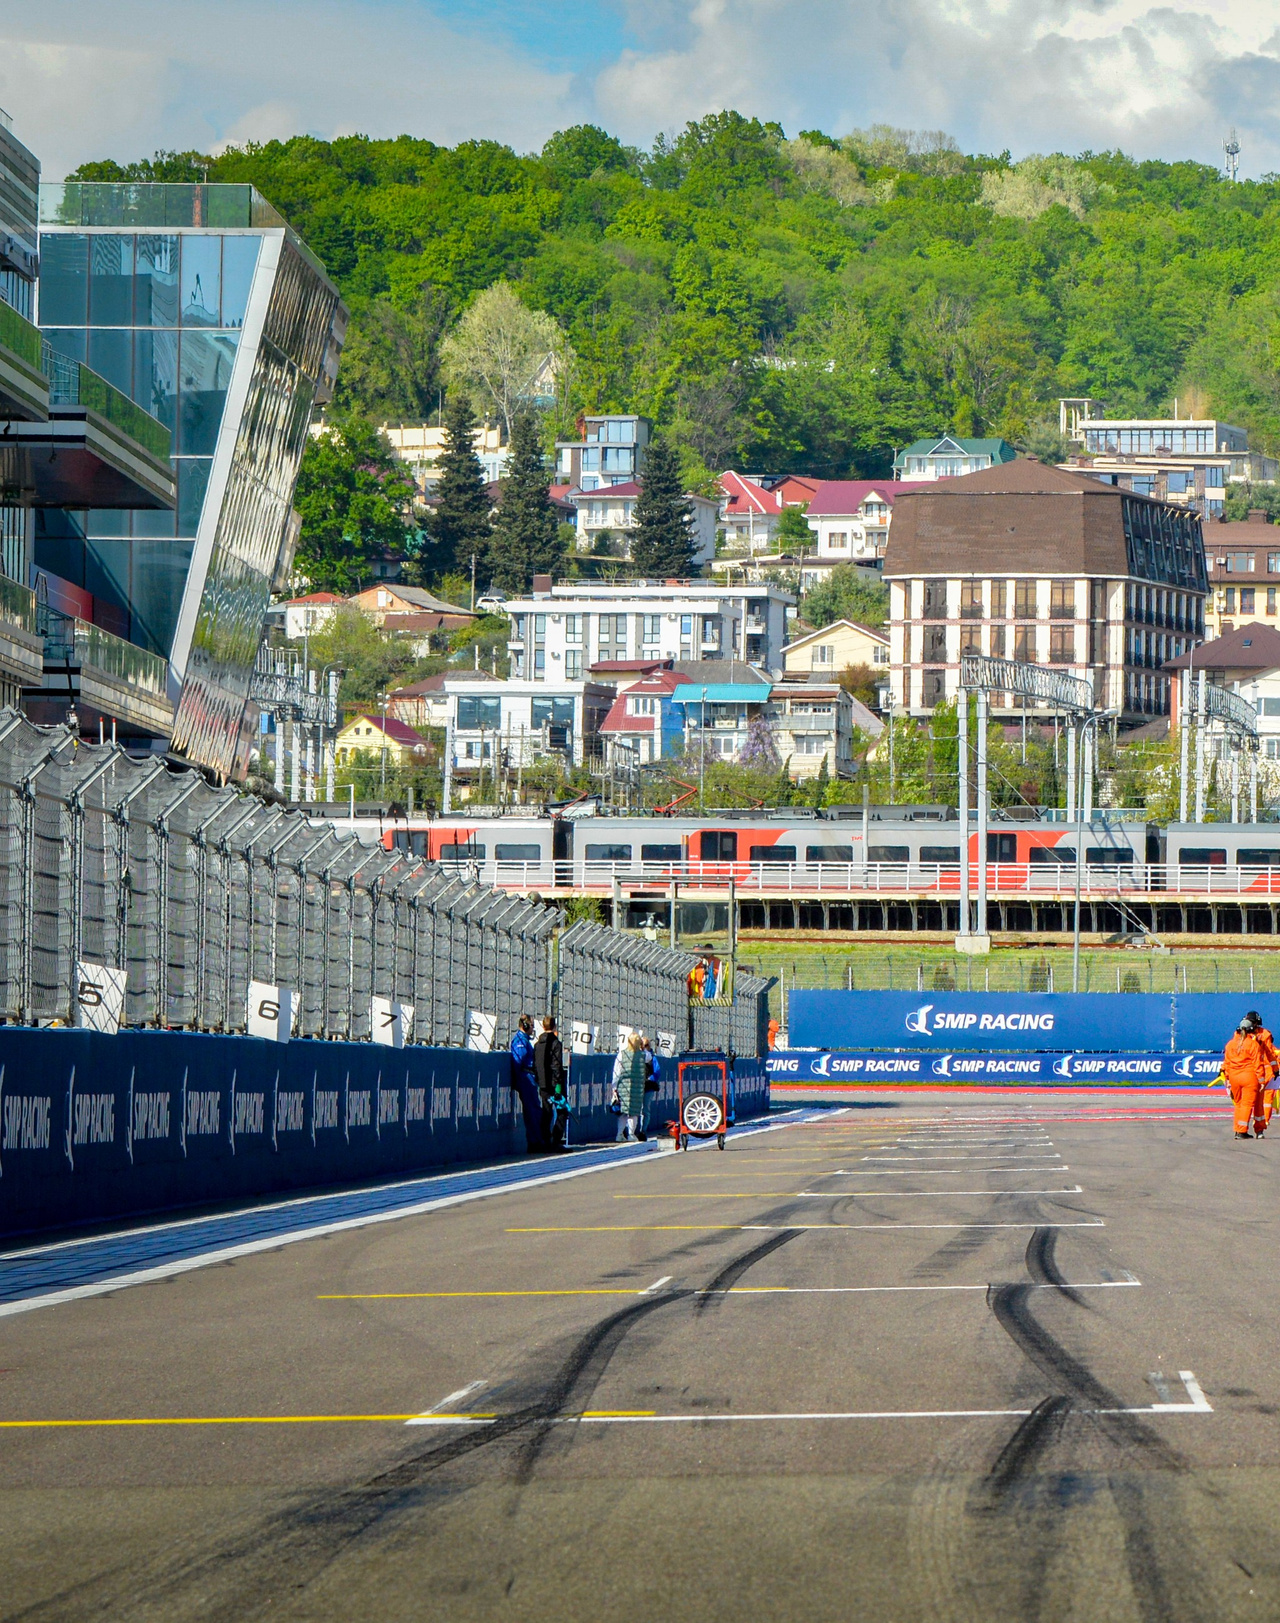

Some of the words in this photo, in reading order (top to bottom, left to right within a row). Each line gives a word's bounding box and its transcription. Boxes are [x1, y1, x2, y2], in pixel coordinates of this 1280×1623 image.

[77, 980, 104, 1007] 5
[257, 999, 281, 1021] 6
[379, 1011, 398, 1028] 7
[933, 1013, 977, 1029] SMP
[979, 1013, 1054, 1030] RACING
[467, 1022, 482, 1037] 8
[571, 1030, 593, 1045] 10
[765, 1059, 799, 1072] CING
[831, 1059, 863, 1072] SMP
[865, 1060, 920, 1072] RACING
[952, 1060, 985, 1073] SMP
[986, 1060, 1041, 1073] RACING
[1073, 1060, 1105, 1073] SMP
[1106, 1060, 1162, 1073] RACING
[1194, 1060, 1223, 1073] SMP
